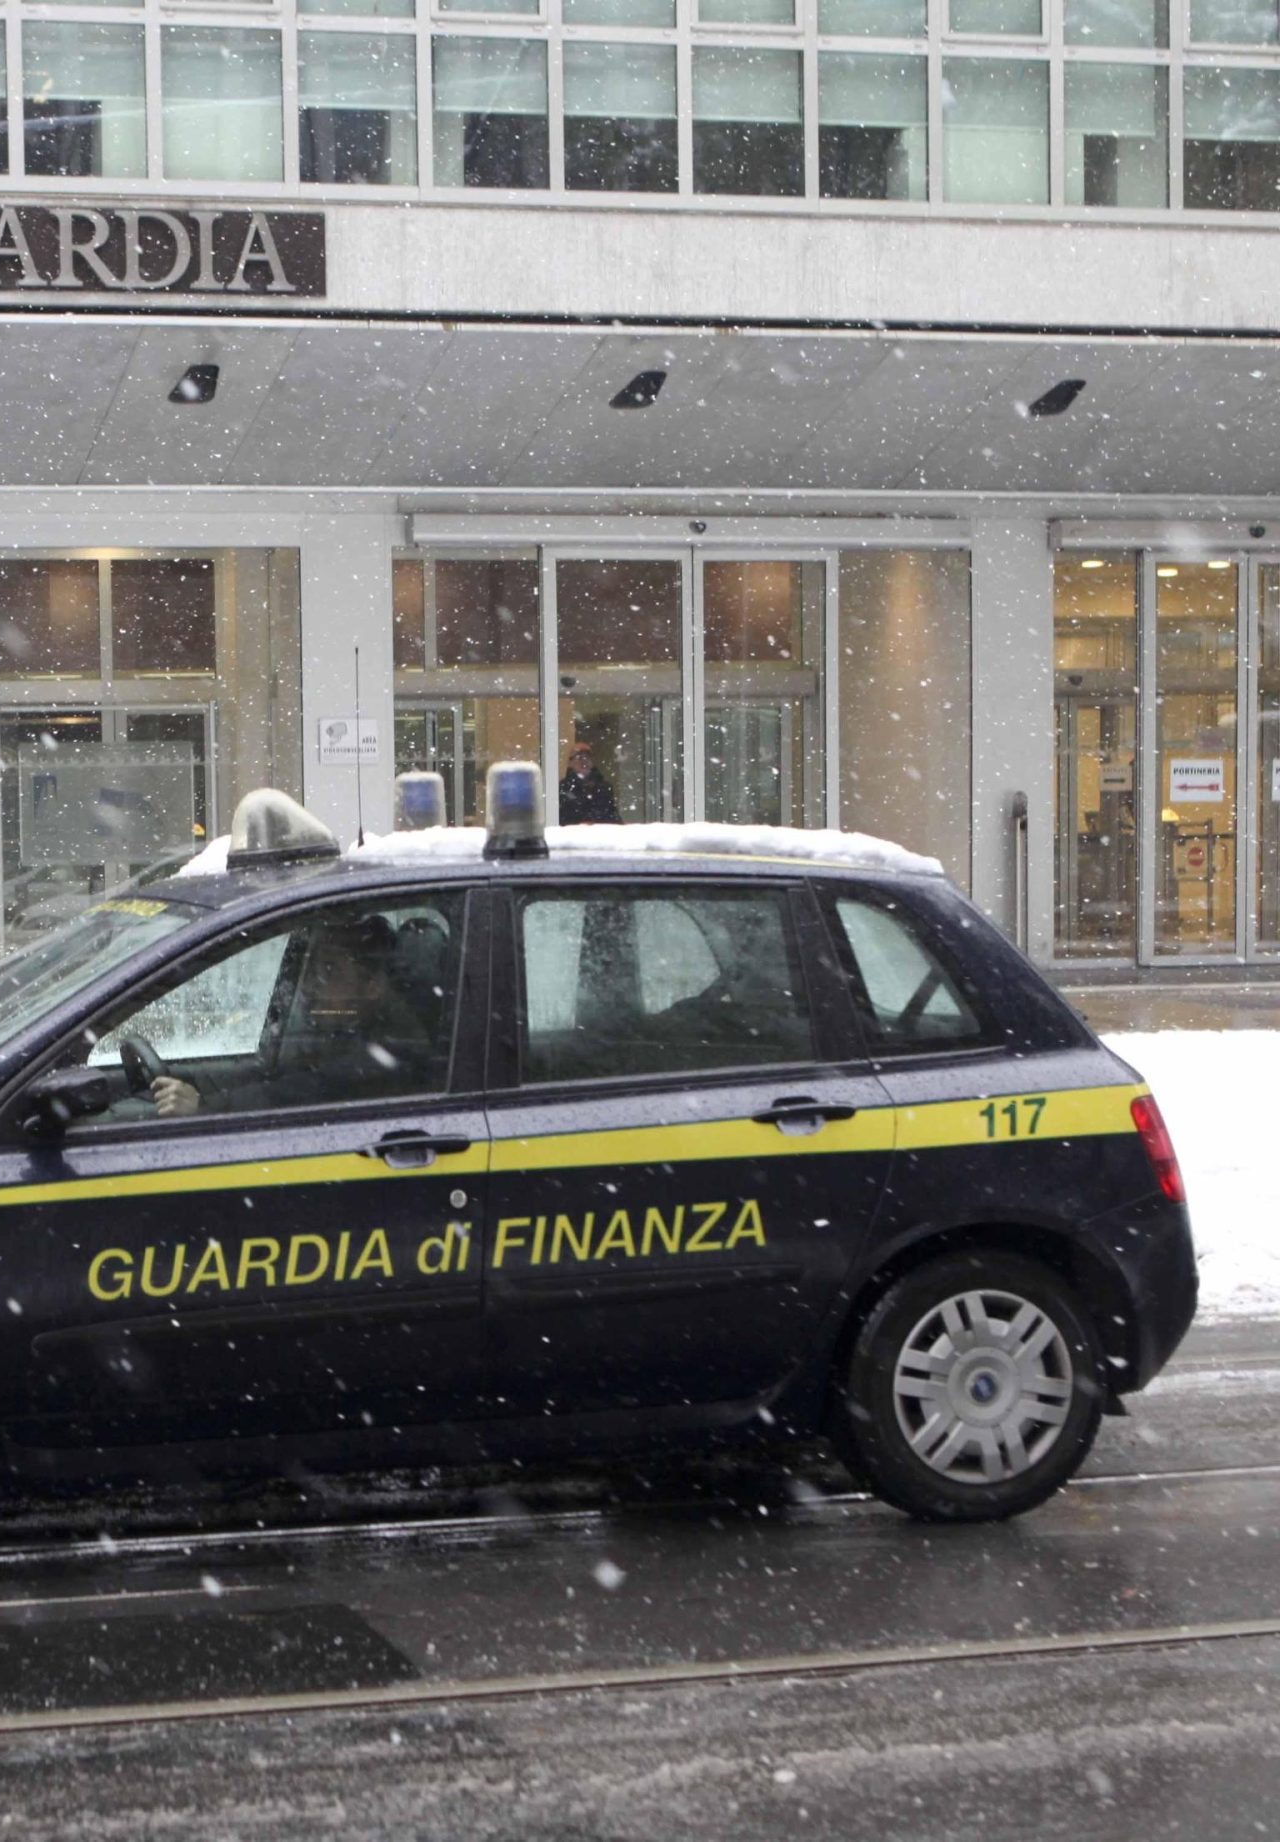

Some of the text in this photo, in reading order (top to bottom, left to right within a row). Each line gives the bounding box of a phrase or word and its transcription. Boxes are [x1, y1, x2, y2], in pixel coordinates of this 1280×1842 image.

[1173, 767, 1220, 776] PORTINERIA
[980, 1097, 1046, 1137] 117
[87, 1199, 767, 1301] GUARDIA di FINANZA
